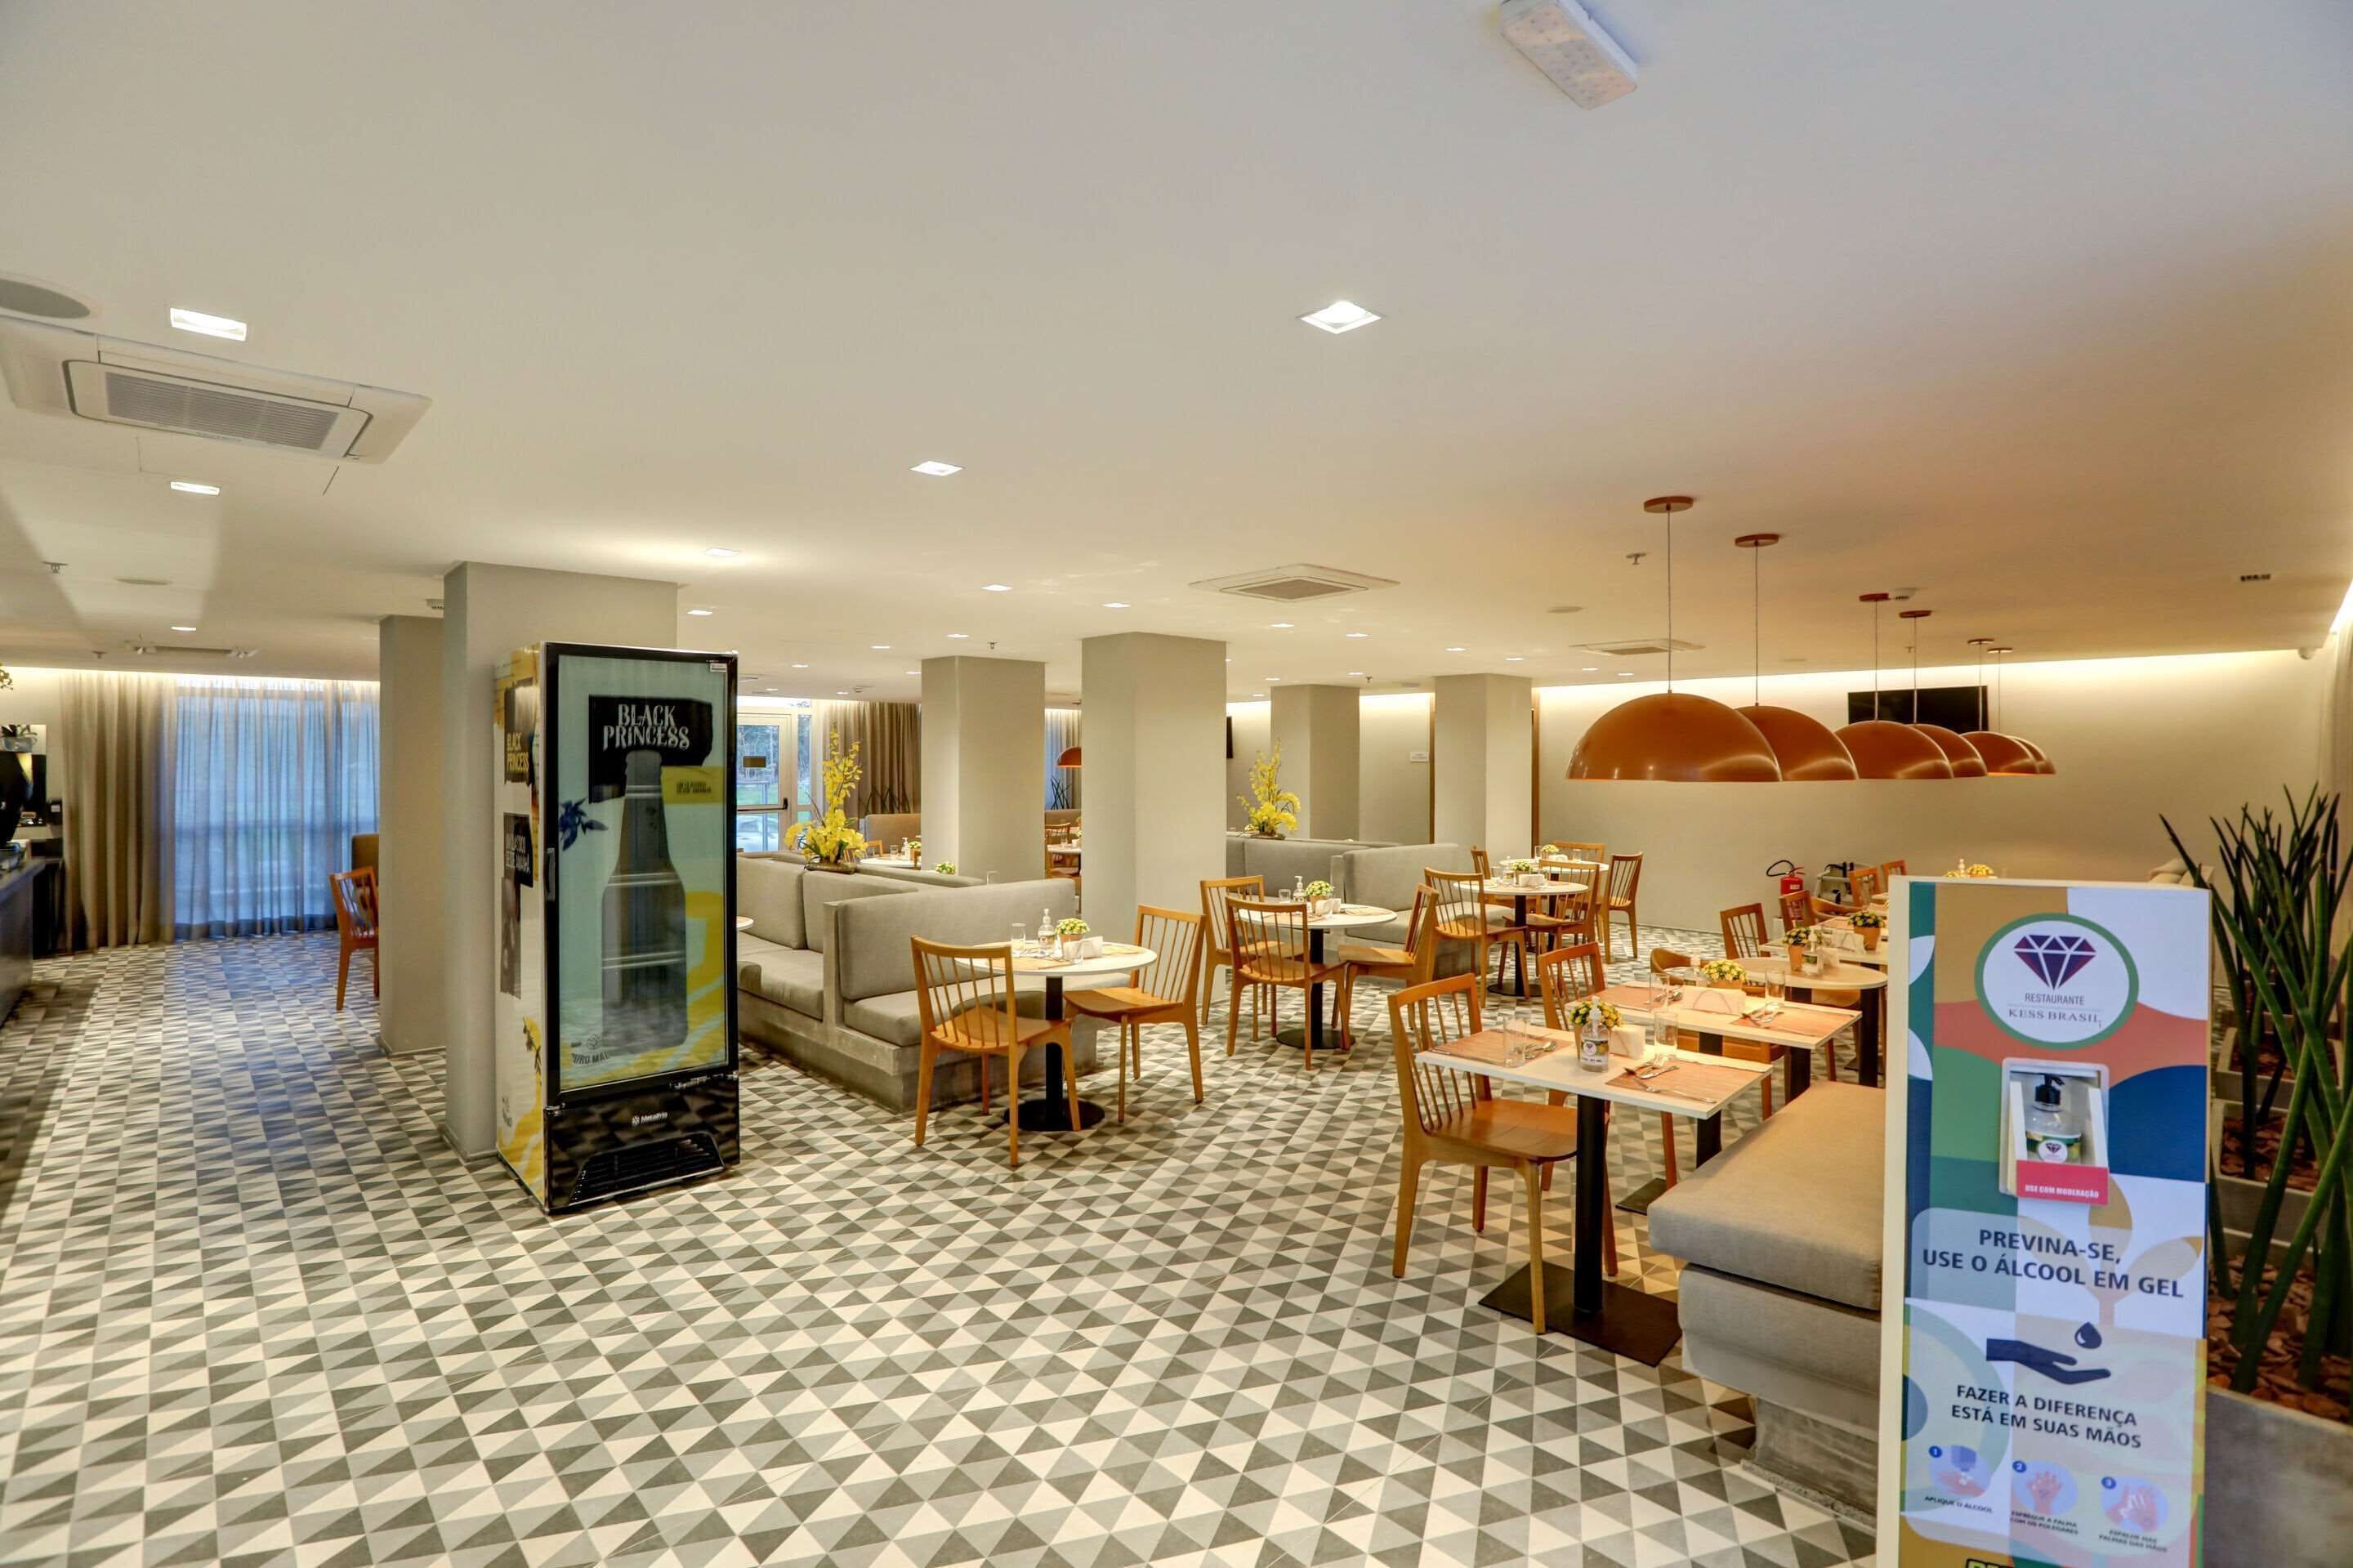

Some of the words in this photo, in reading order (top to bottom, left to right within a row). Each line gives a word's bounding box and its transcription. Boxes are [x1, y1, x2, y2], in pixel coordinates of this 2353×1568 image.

[618, 704, 676, 726] BLACK
[507, 731, 522, 752] BLACK
[603, 725, 690, 752] PRINCESS
[2025, 993, 2085, 1006] RESTAURANTE
[2008, 1008, 2045, 1020] KESS
[2047, 1011, 2100, 1023] BRASIL
[2025, 1184, 2038, 1192] USE
[2038, 1186, 2056, 1195] COM
[2056, 1187, 2100, 1199] MODERAÇÃO
[1979, 1229, 2121, 1264] PREVINA-SE,
[1922, 1249, 1963, 1270] USE
[1971, 1255, 1988, 1272] O
[1994, 1253, 2086, 1285] ÁLCOOL
[2093, 1270, 2129, 1291] EM
[2137, 1276, 2184, 1298] GEL
[1957, 1385, 2010, 1405] FAZER
[2015, 1394, 2028, 1408] A
[2034, 1396, 2137, 1428] DIFERENÇA
[1951, 1405, 1994, 1423] ESTÁ
[2000, 1413, 2027, 1429] EM
[2033, 1418, 2080, 1438] SUAS
[2086, 1427, 2142, 1449] MÃOS
